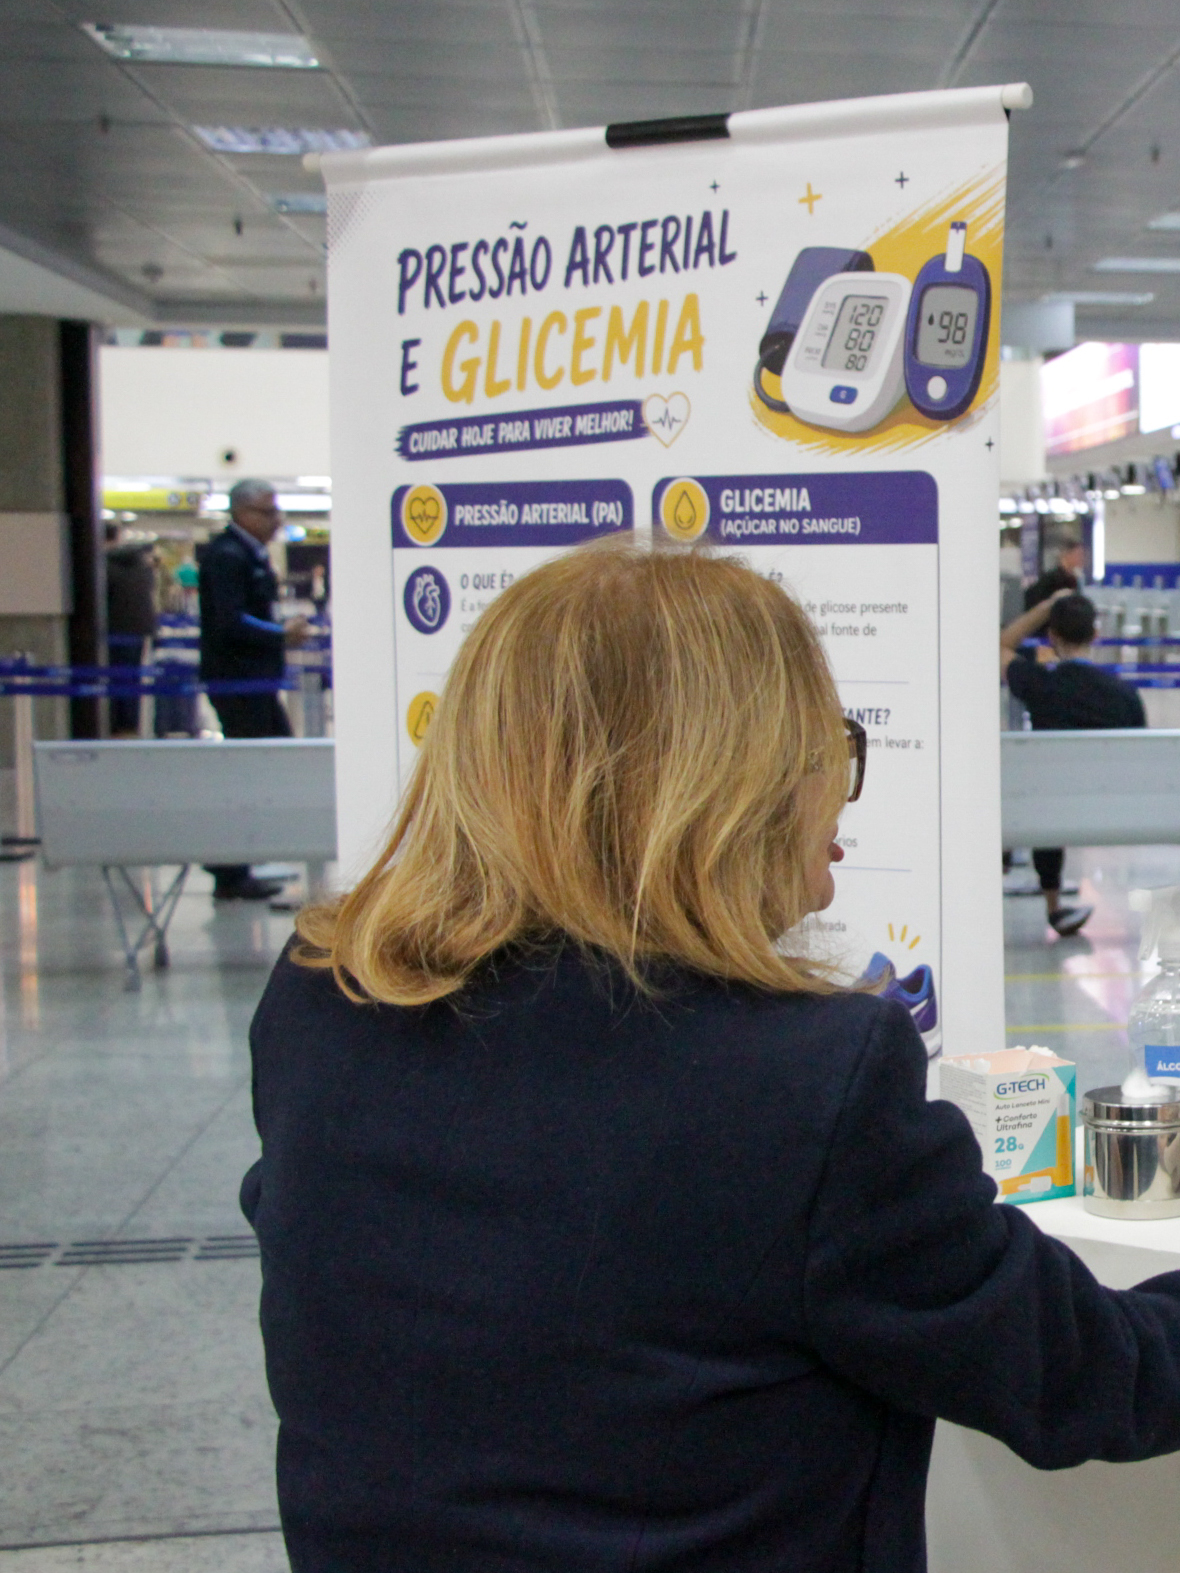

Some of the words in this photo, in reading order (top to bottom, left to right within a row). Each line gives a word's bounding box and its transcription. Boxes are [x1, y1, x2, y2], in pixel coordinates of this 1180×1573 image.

[397, 221, 552, 316] PRESSÃO
[564, 209, 737, 288] ARTERIAL
[850, 303, 884, 327] 120
[938, 311, 968, 344] 98
[400, 338, 422, 396] E
[441, 293, 705, 405] GLICEMIA
[845, 328, 875, 352] 80
[845, 354, 867, 371] 80
[409, 427, 458, 453] CUIDAR
[461, 423, 495, 448] HOJE
[498, 420, 530, 443] PARA
[534, 416, 572, 440] VIVER
[575, 409, 634, 436] MELHOR!
[720, 488, 811, 513] GLICEMIA
[454, 500, 519, 526] PRESSÃO
[521, 502, 589, 525] ARTERIAL
[592, 500, 623, 526] (PA)
[720, 516, 776, 537] (AÇÚCAR
[779, 519, 799, 534] NO
[802, 516, 861, 536] SANGUE)
[460, 573, 469, 589] O
[473, 573, 496, 590] QUE
[820, 600, 856, 617] glicose
[860, 601, 909, 616] presente
[831, 622, 860, 636] fonte
[863, 623, 877, 636] de
[843, 708, 891, 725] ANTE?
[885, 735, 912, 749] levar
[996, 1120, 1033, 1132] Ultrafina
[1003, 1112, 1037, 1123] Conforto
